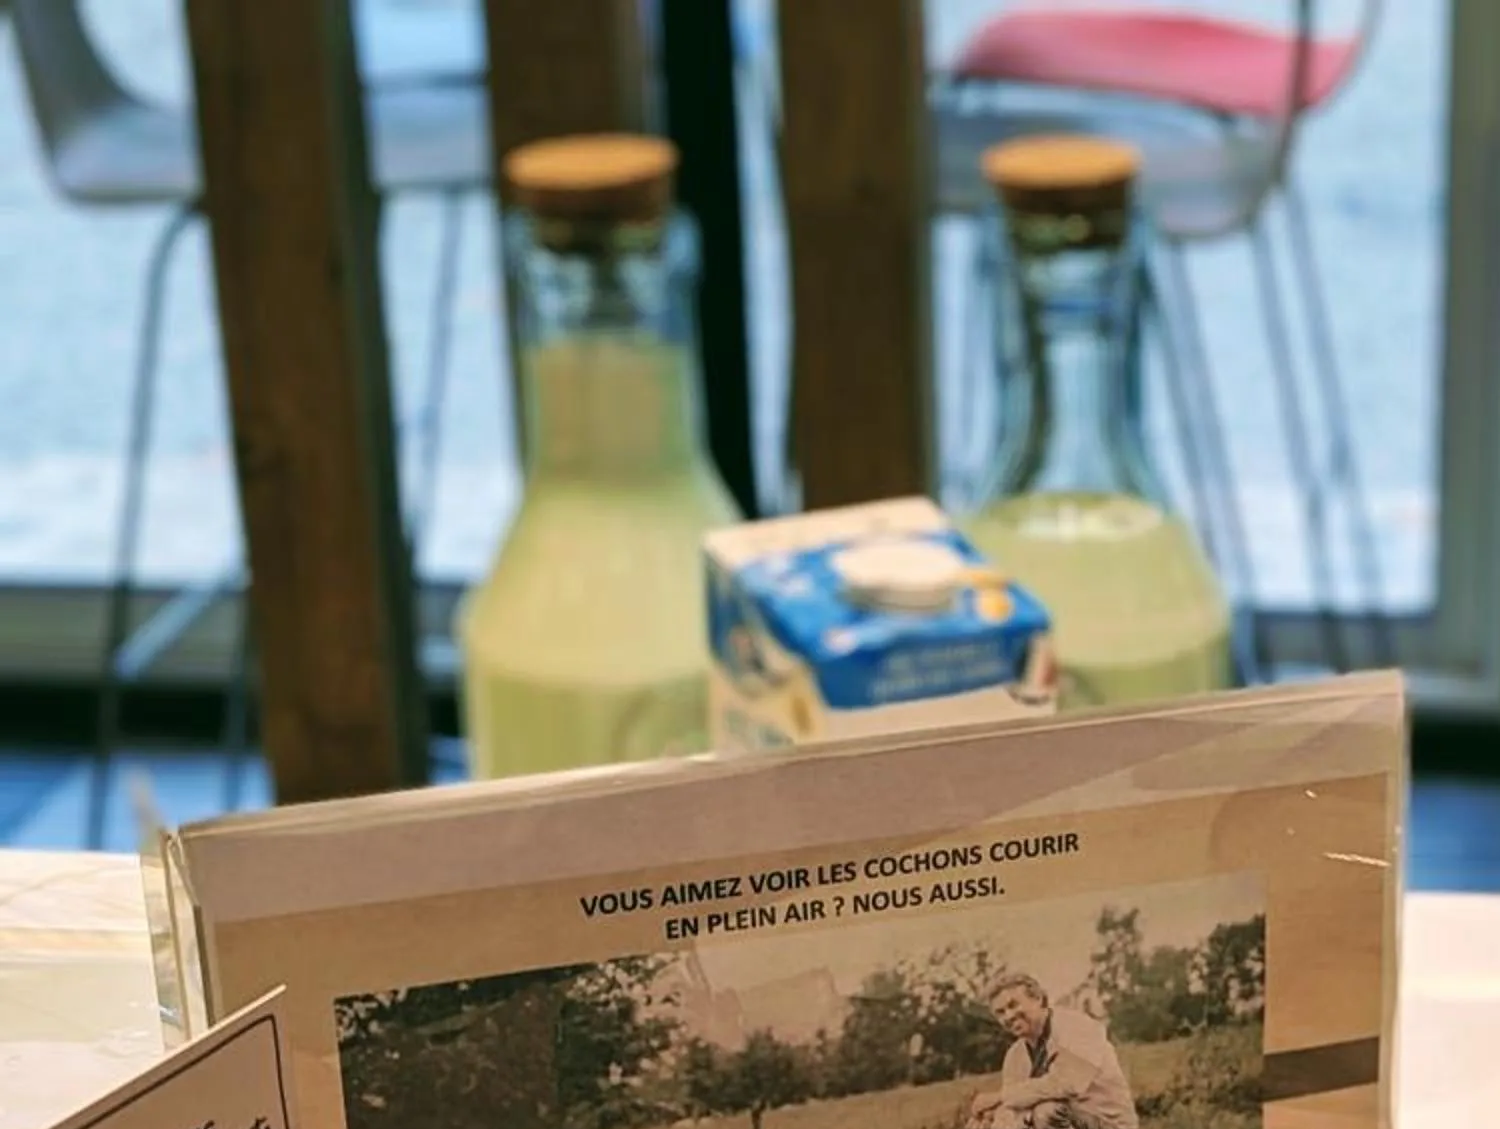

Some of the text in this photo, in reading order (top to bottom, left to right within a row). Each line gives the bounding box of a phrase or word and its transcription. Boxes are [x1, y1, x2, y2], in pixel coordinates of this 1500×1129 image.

[580, 832, 1080, 919] VOUS AIMEZ VOIR LES COCHONS COURIR
[665, 876, 1006, 941] EN PLEIN AIR ? NOUS AUSSI.
